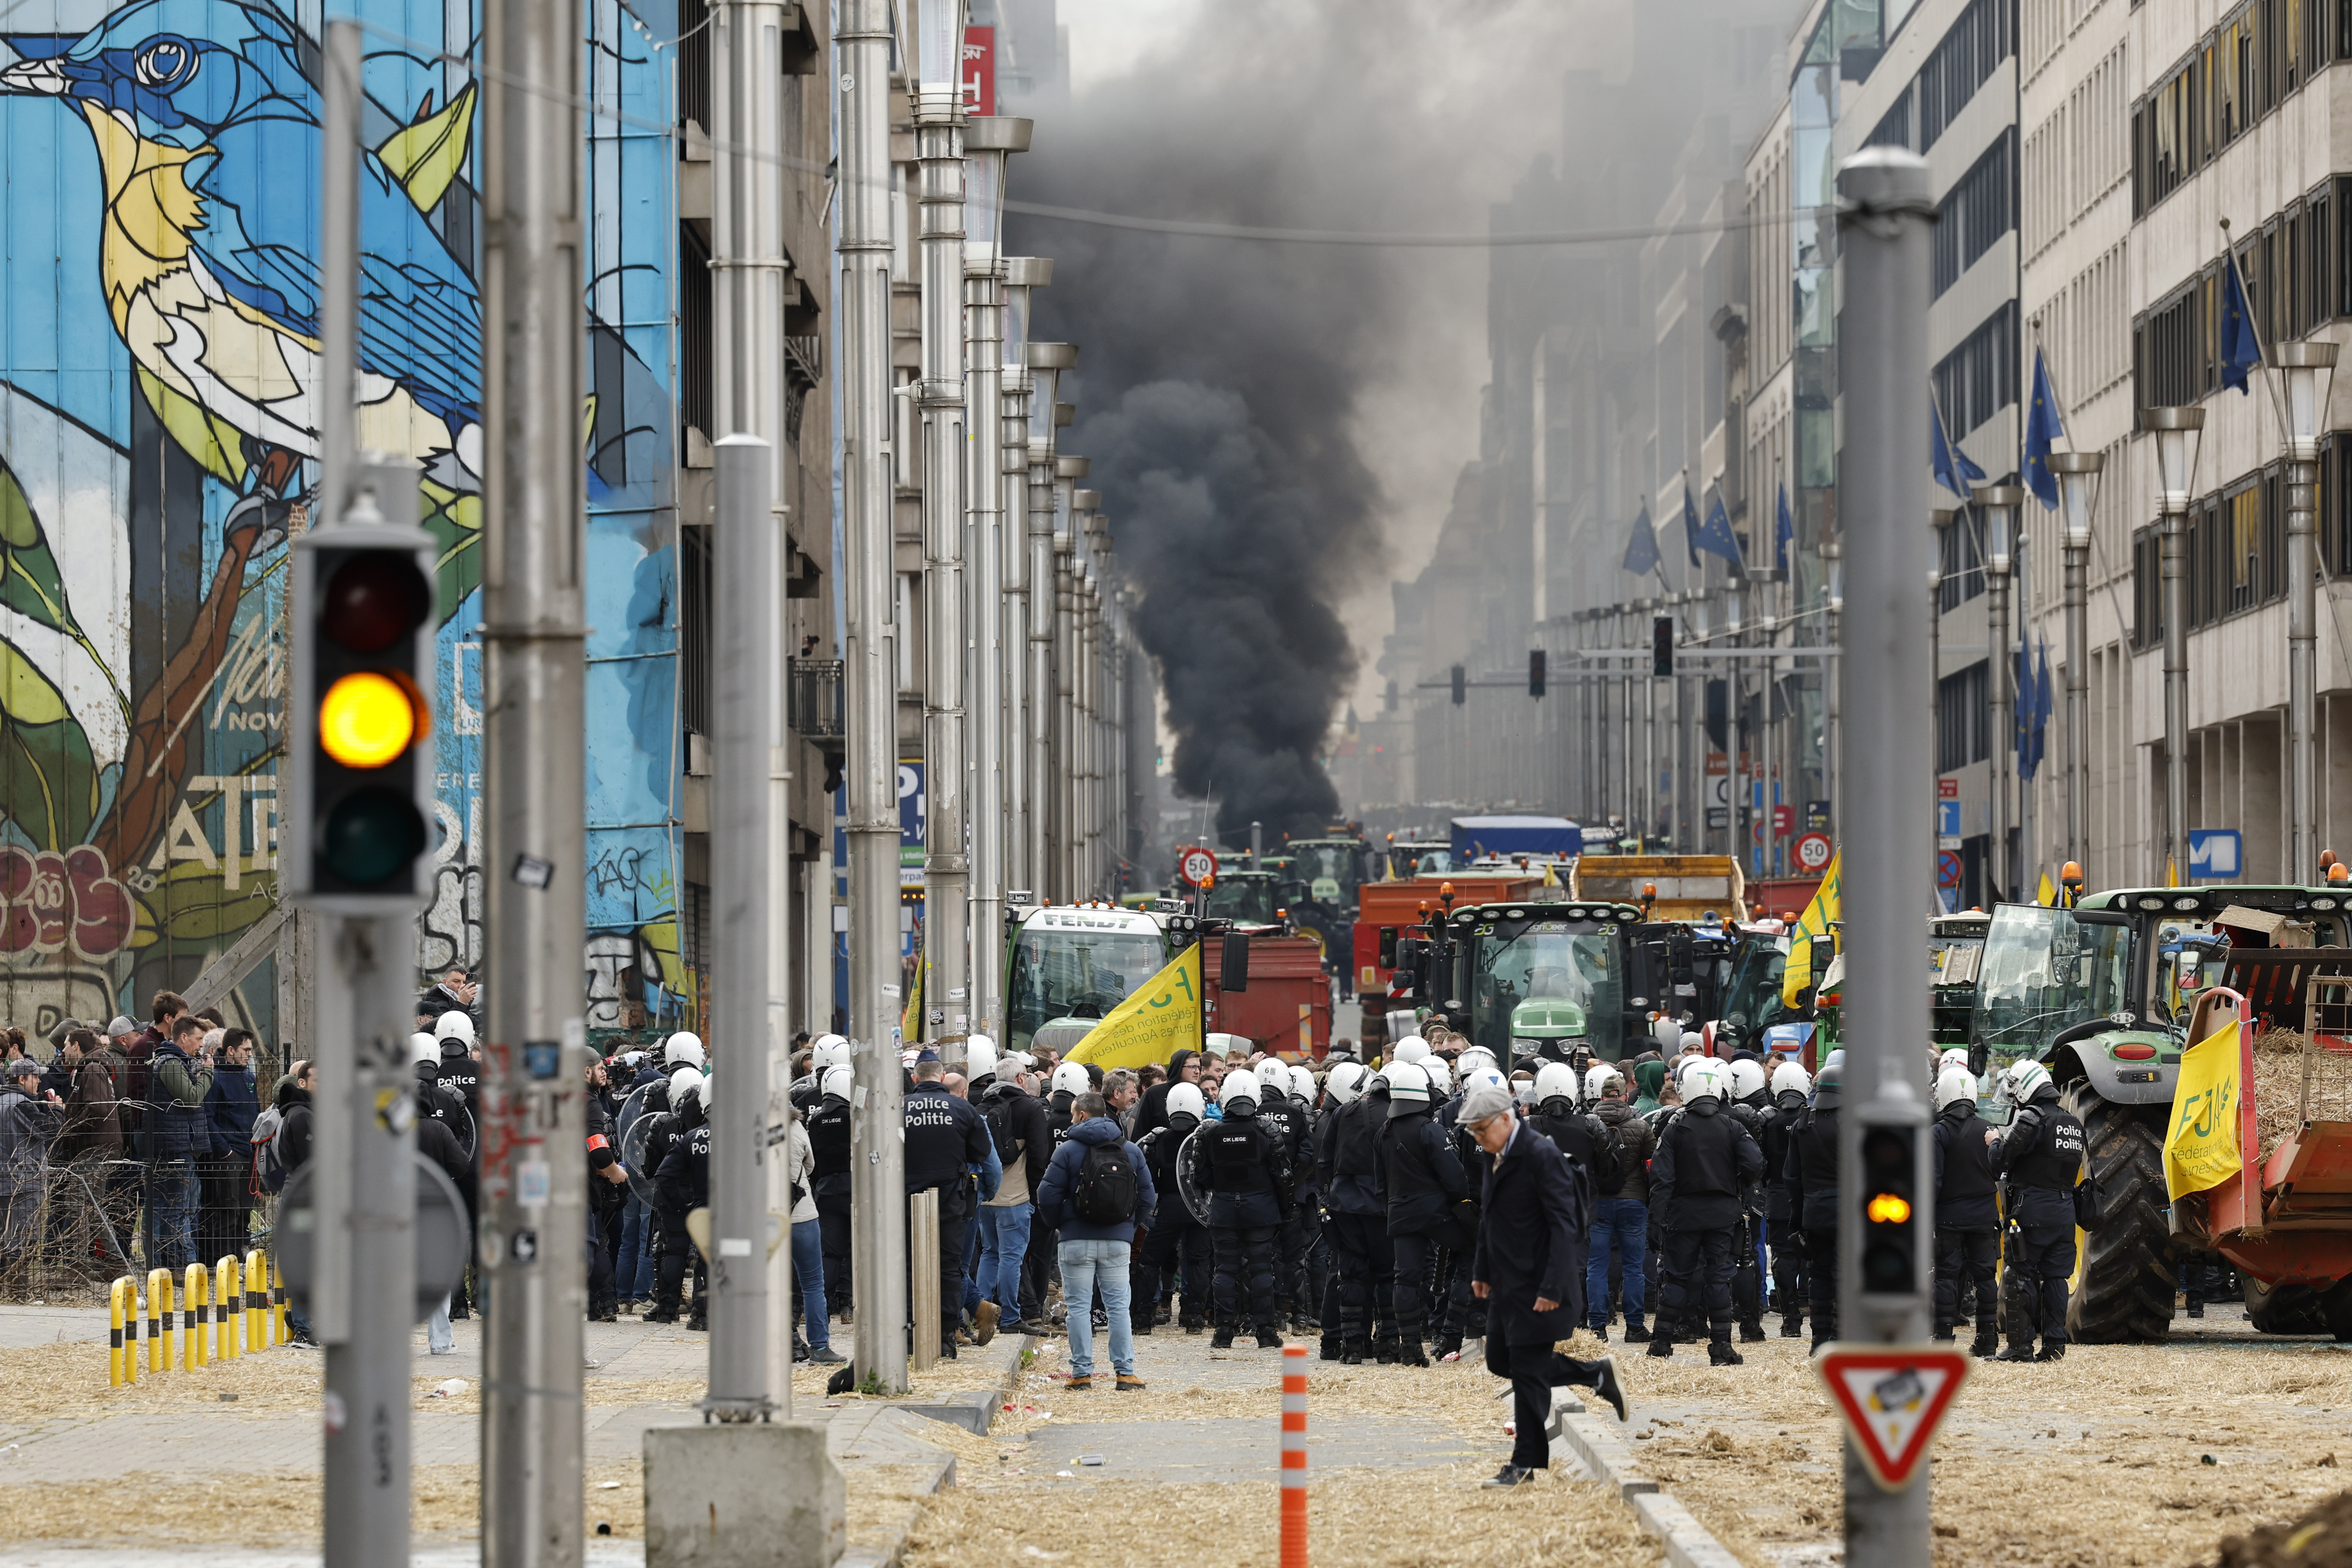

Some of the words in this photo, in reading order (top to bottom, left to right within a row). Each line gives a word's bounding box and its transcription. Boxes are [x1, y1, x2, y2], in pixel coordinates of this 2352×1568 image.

[1804, 844, 1824, 857] 50
[1189, 859, 1208, 872] 50
[1044, 914, 1136, 929] FENDT
[438, 1075, 476, 1087] Police
[1590, 1079, 1593, 1088] 6
[907, 1098, 949, 1112] Police
[905, 1112, 953, 1128] Politie
[2056, 1125, 2082, 1137] Police
[2056, 1138, 2082, 1152] Politie
